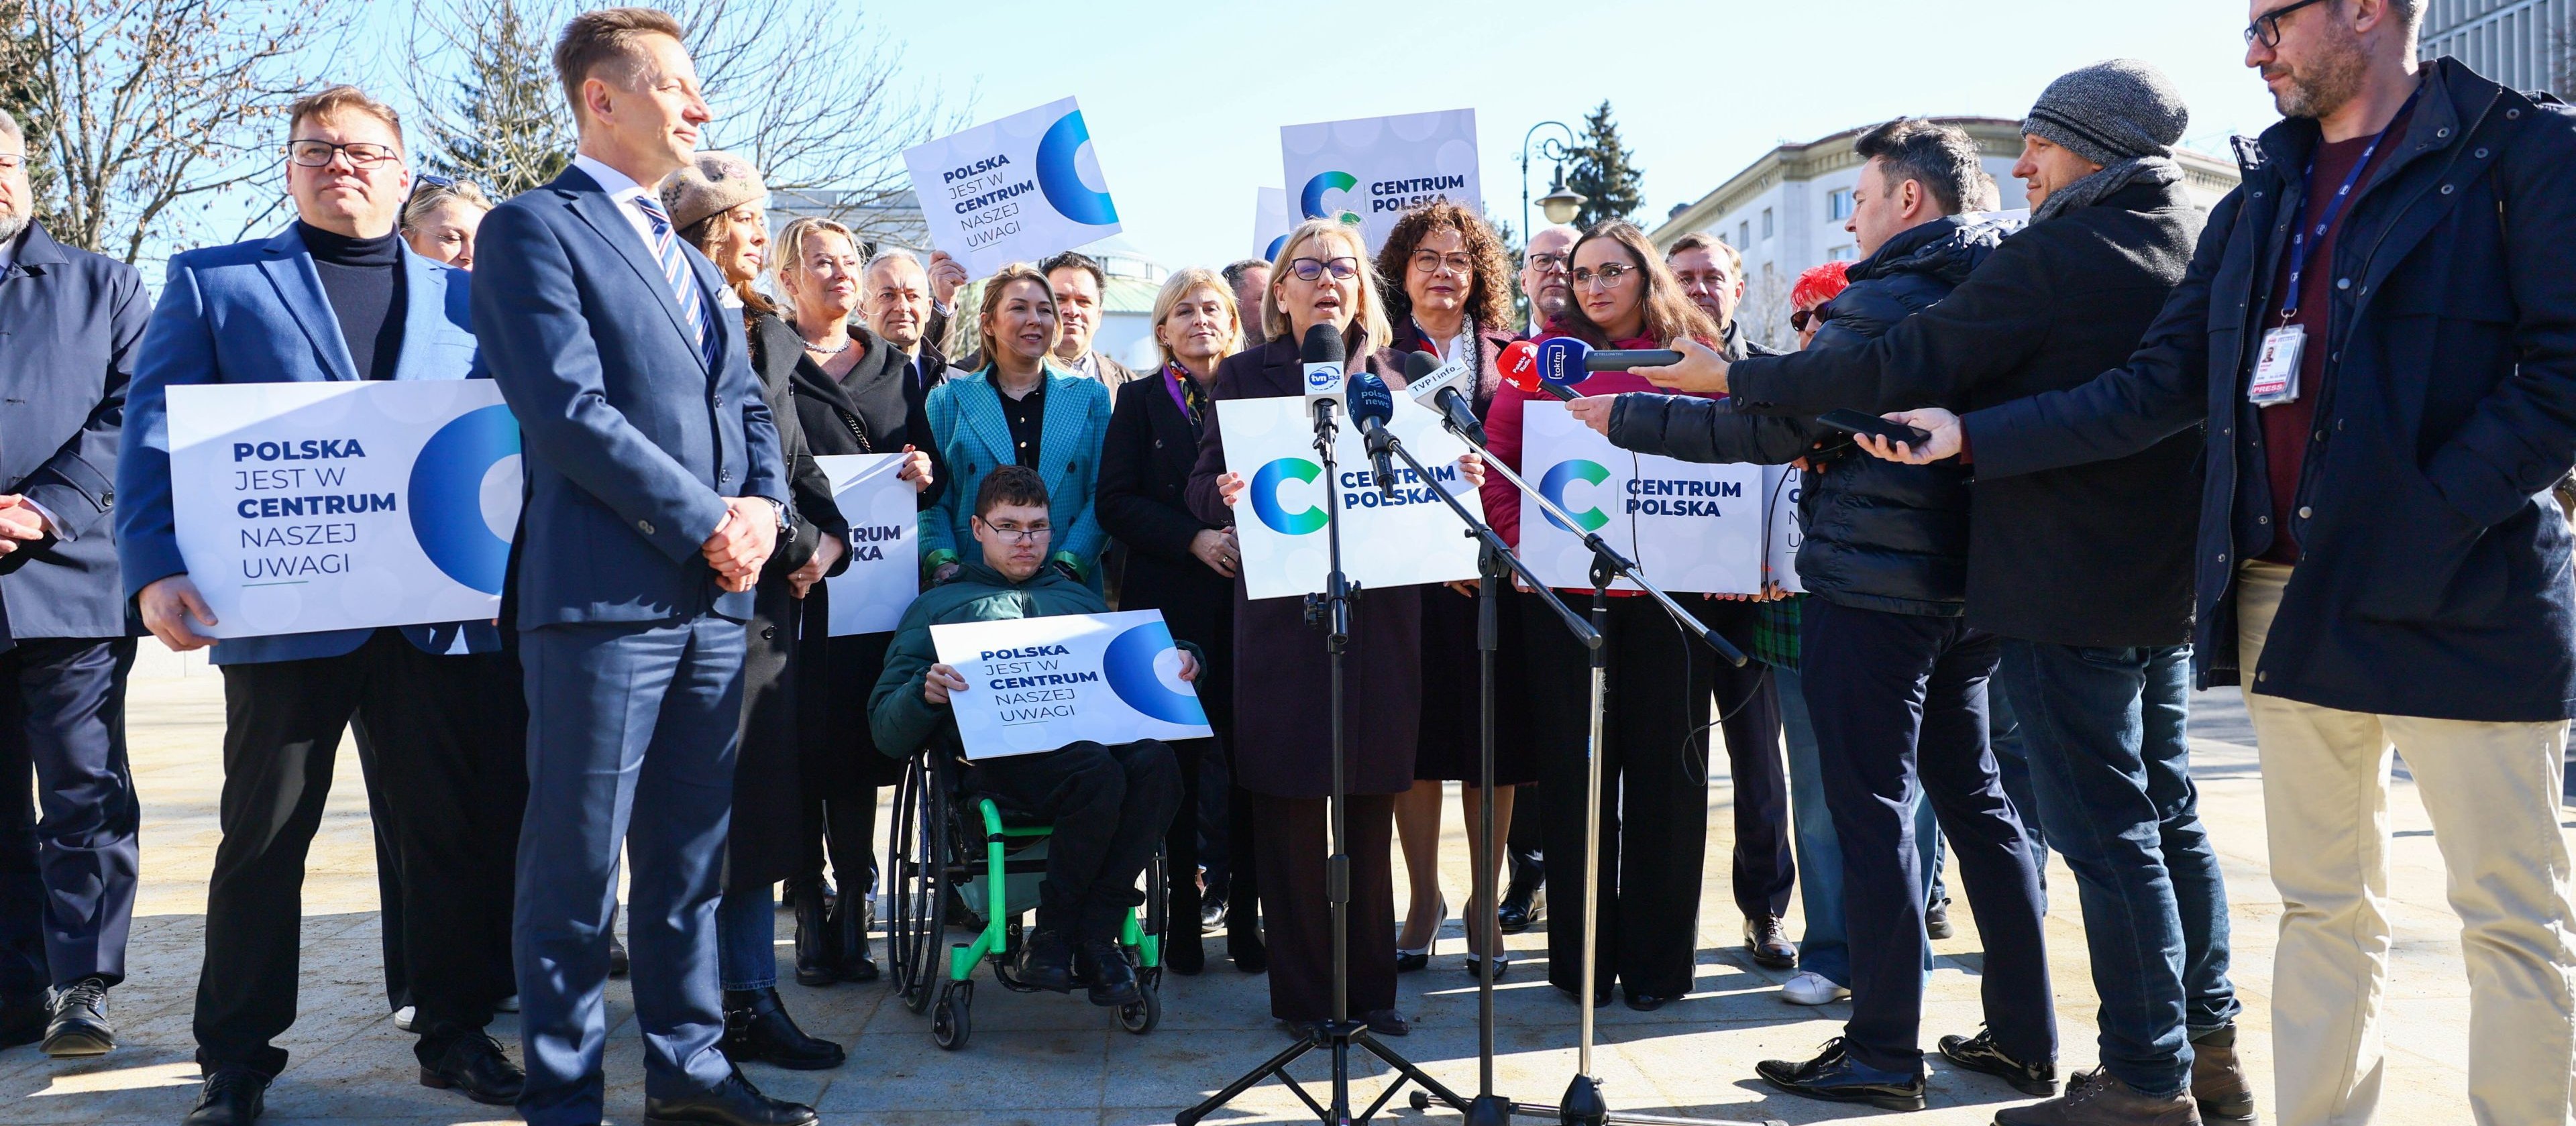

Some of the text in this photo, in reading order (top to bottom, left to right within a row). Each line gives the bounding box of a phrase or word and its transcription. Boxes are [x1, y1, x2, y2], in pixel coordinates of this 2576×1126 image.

[943, 154, 1010, 184] POLSKA
[949, 172, 1003, 200] JEST W
[1371, 174, 1464, 196] CENTRUM
[955, 179, 1034, 215] CENTRUM
[961, 203, 1020, 231] NASZEJ
[966, 221, 1022, 247] UWAGI
[1513, 356, 1526, 374] Polskie
[1519, 359, 1531, 372] Radio
[1412, 378, 1432, 392] TVP
[2253, 384, 2283, 393] PRESS
[1361, 390, 1391, 402] polsat
[1365, 399, 1389, 408] news
[233, 439, 366, 463] POLSKA
[235, 467, 345, 491] JEST W
[1626, 479, 1741, 498] CENTRUM
[237, 492, 396, 519] CENTRUM
[1344, 487, 1442, 510] POLSKA
[1626, 499, 1721, 517] POLSKA
[241, 522, 356, 549] NASZEJ
[243, 554, 350, 579] UWAGI
[981, 644, 1071, 661] POLSKA
[985, 659, 1059, 676] JEST W
[989, 671, 1099, 690] CENTRUM
[995, 688, 1076, 706] NASZEJ
[1000, 705, 1076, 722] UWAGI
